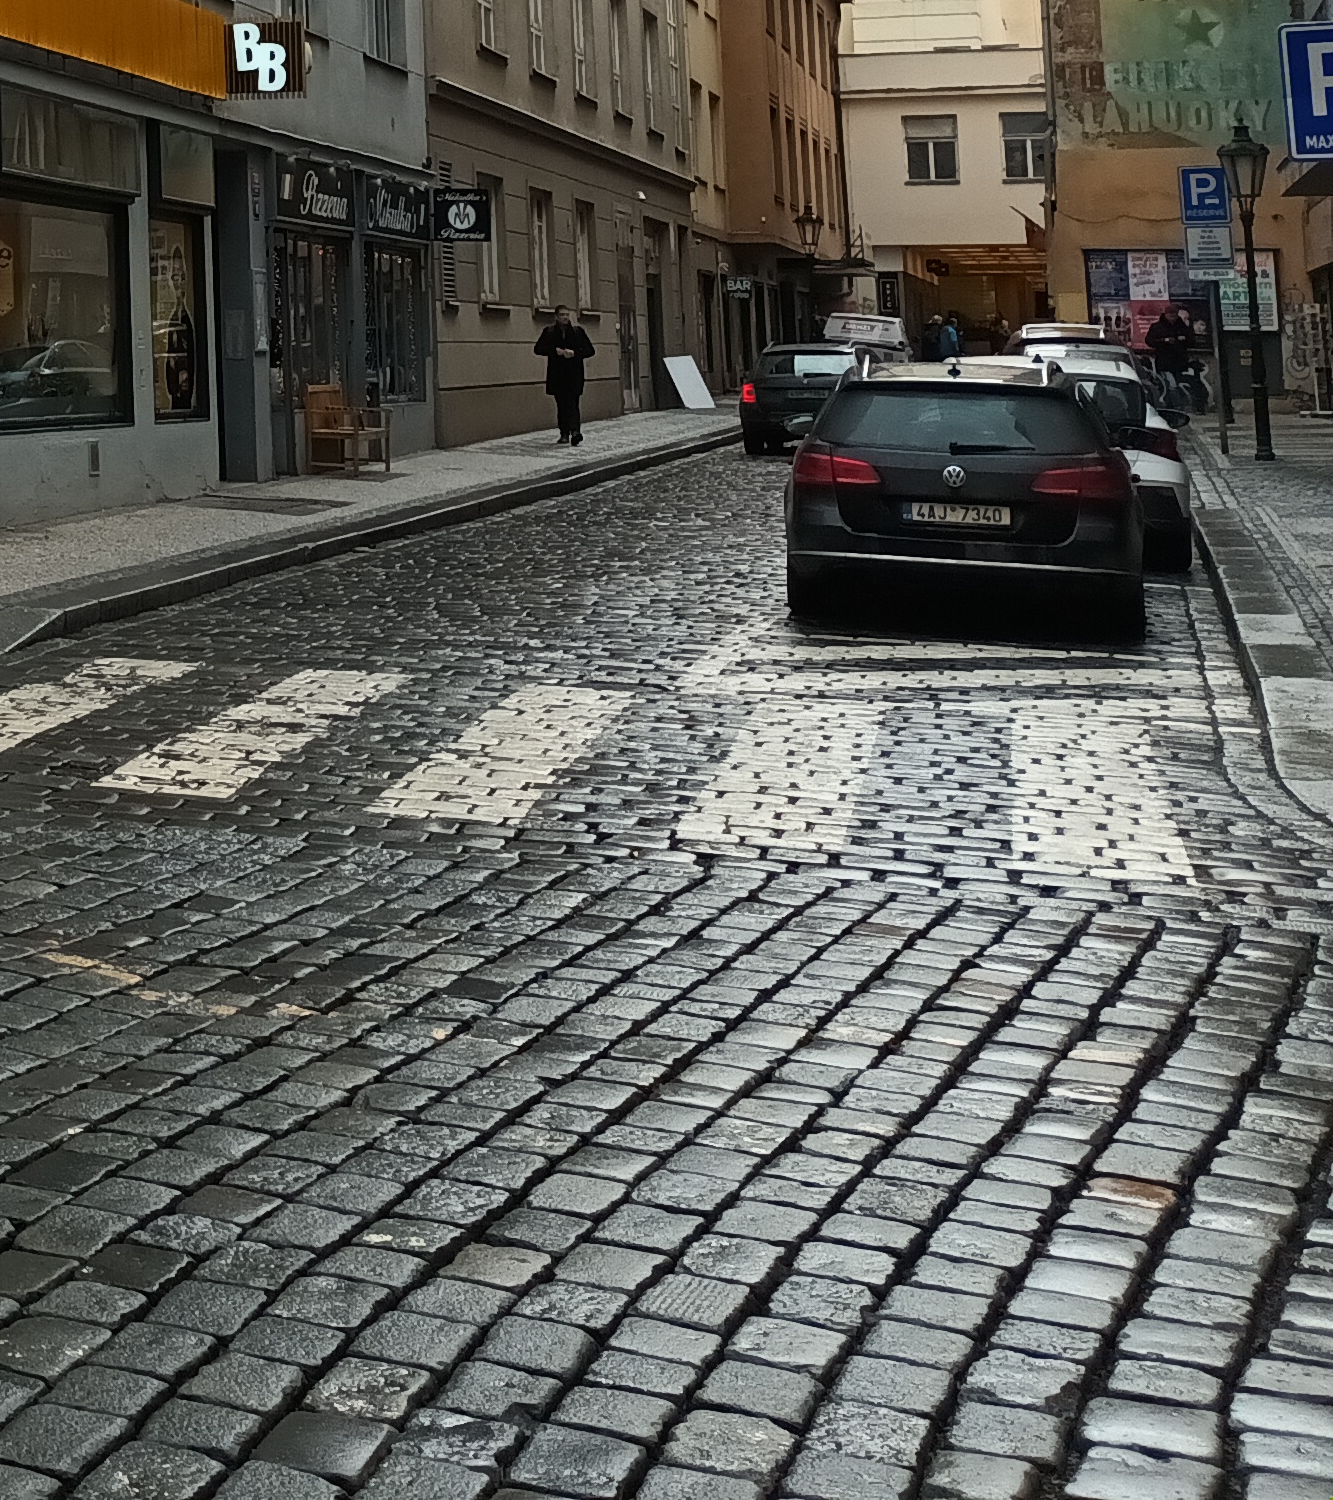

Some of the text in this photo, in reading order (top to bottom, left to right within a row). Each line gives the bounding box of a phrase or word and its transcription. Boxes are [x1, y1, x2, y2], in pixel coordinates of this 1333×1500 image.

[233, 22, 287, 92] BB
[300, 169, 349, 221] Pizzeria
[1189, 173, 1217, 206] P
[368, 187, 418, 234] Mikulka's
[726, 279, 752, 291] BAR
[916, 504, 1003, 523] 4AJ 7340
